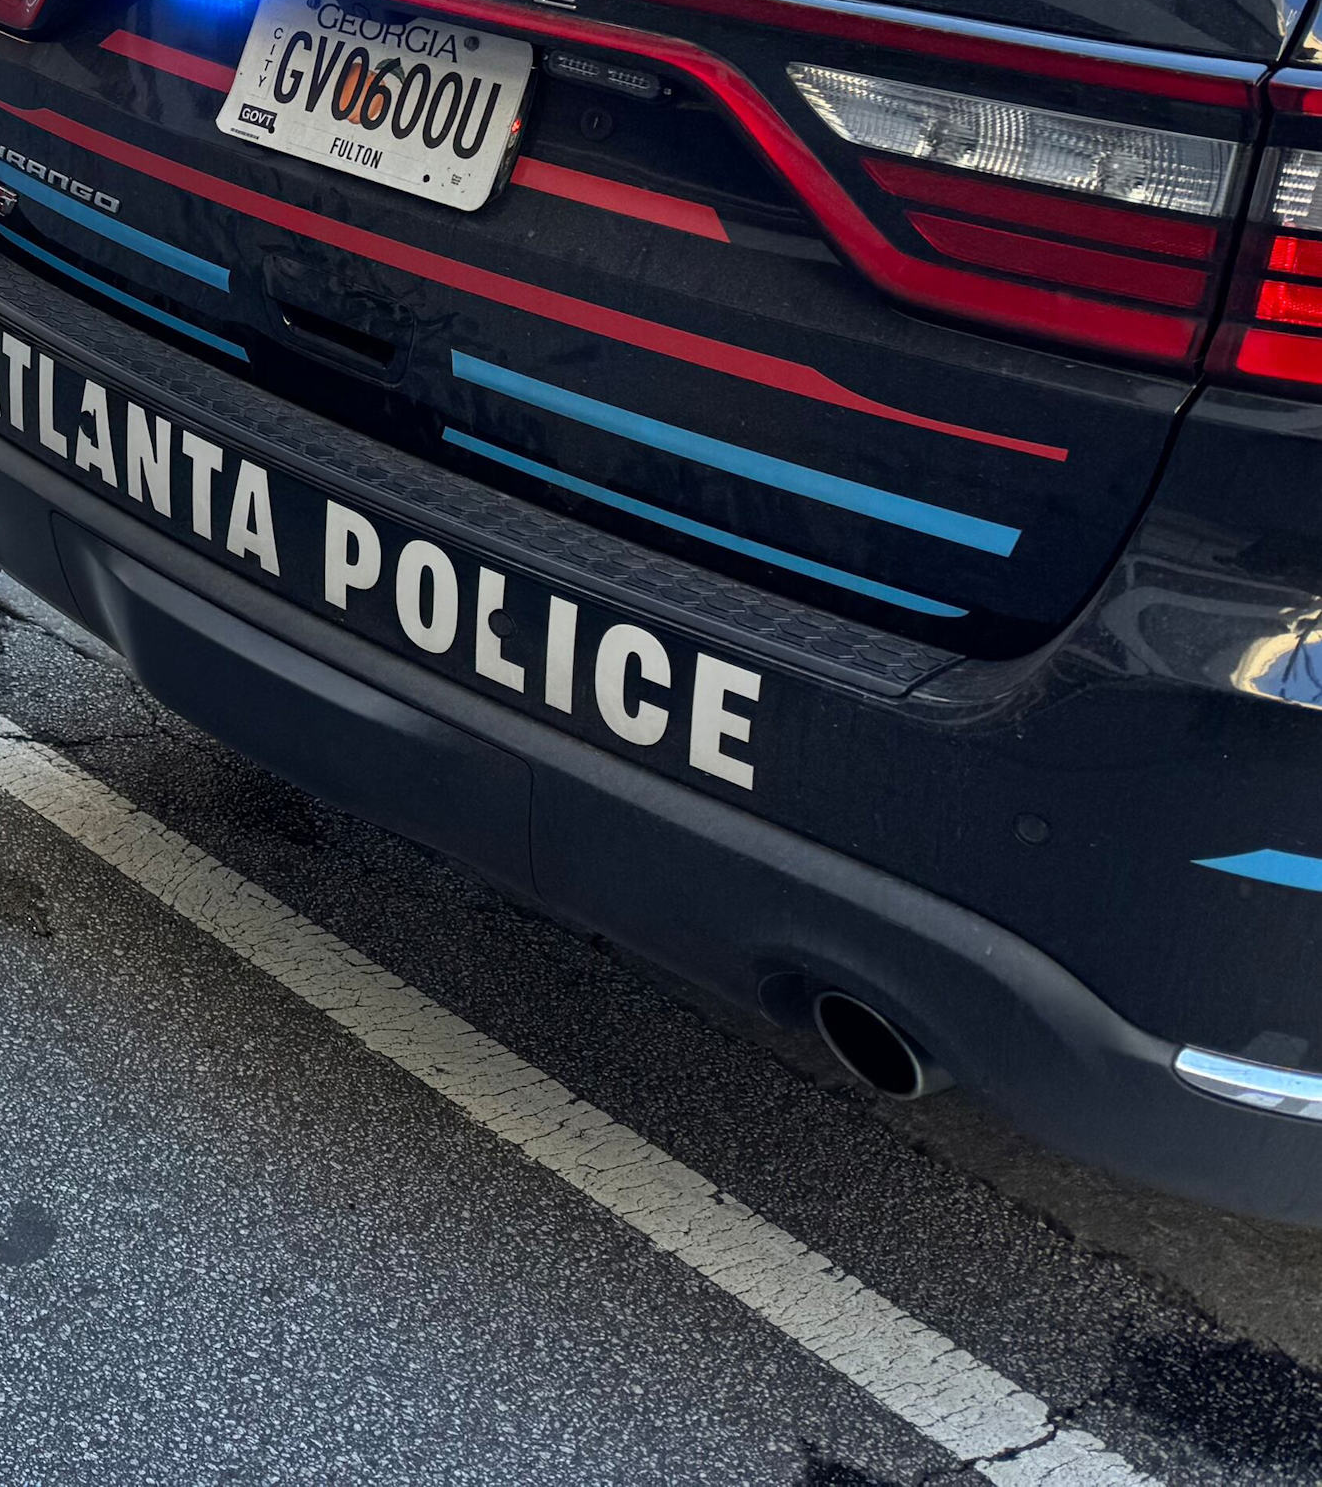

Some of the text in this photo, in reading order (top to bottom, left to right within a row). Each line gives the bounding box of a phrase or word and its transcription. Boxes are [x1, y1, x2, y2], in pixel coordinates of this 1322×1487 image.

[258, 27, 284, 88] CITY
[317, 3, 458, 63] GEORGIA
[242, 108, 275, 127] GOVT
[273, 30, 502, 159] GV0600U
[330, 137, 383, 170] FULTON
[324, 499, 763, 791] POLICE
